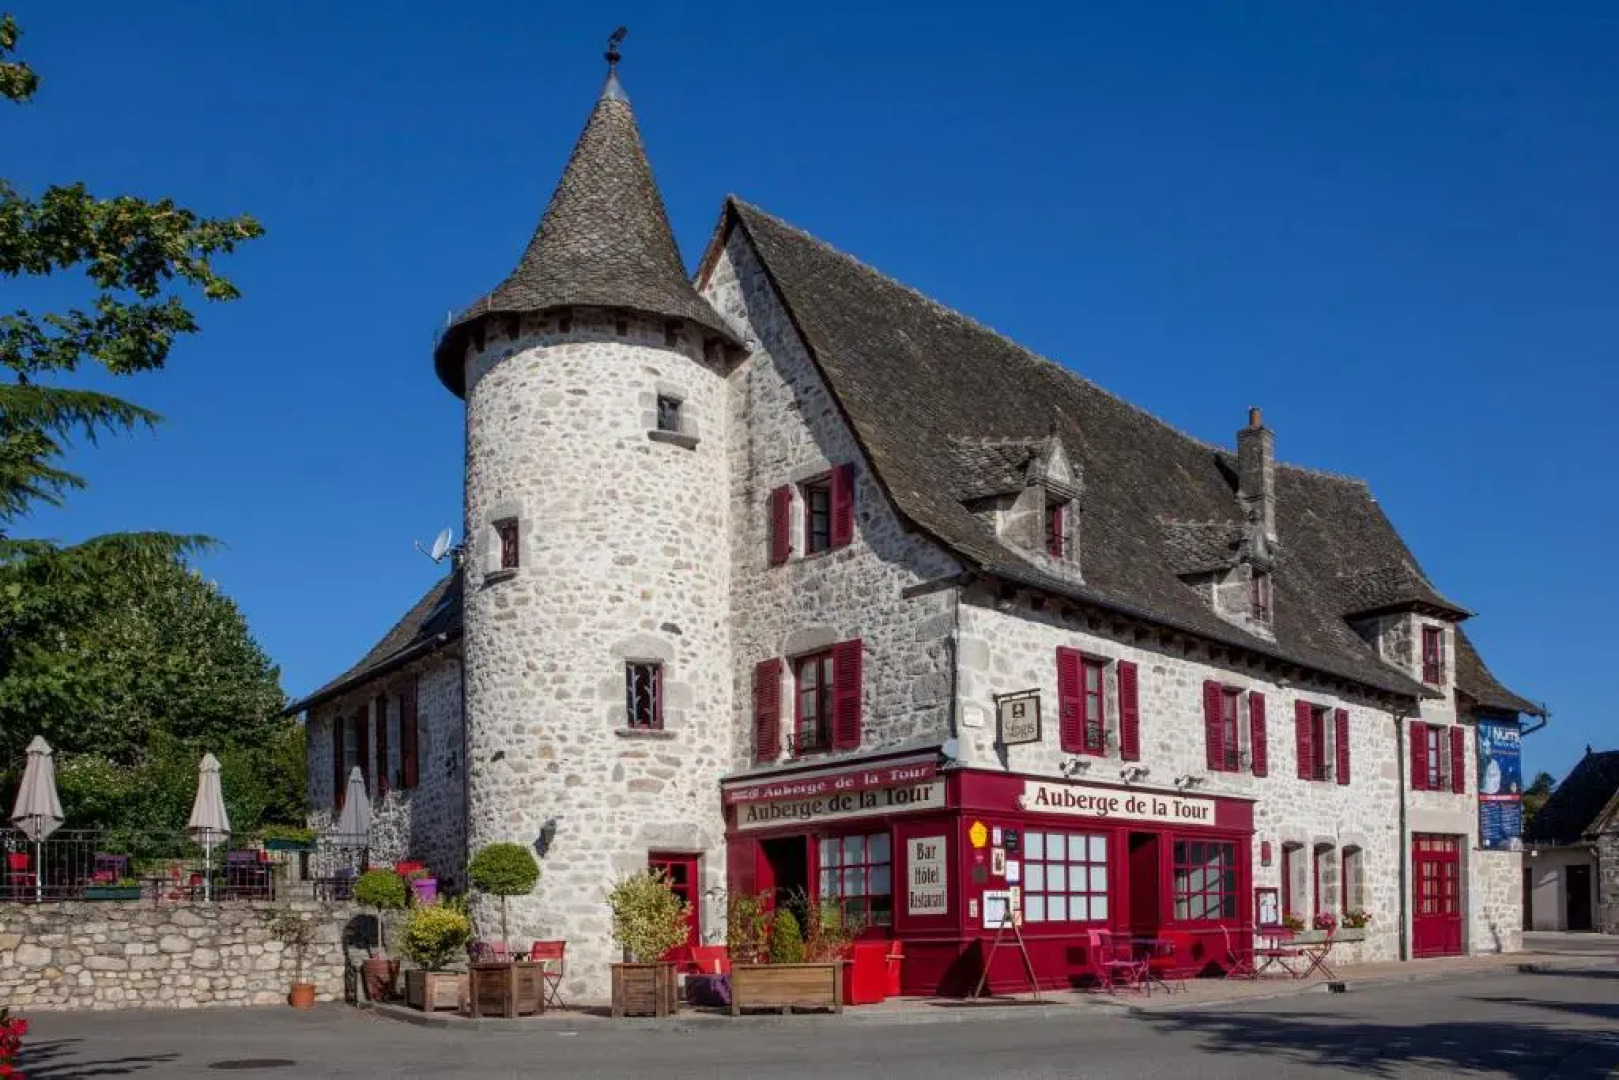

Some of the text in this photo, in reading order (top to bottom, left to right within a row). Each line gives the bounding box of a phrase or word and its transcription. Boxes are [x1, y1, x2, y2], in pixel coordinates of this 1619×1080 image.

[763, 781, 825, 798] Auberge
[835, 777, 855, 789] de
[864, 772, 879, 785] la
[891, 767, 929, 781] Tour
[746, 785, 933, 822] Auberge de la Tour
[1035, 786, 1209, 820] Auberge de la Tour
[916, 842, 937, 861] Bar
[914, 866, 940, 884] Hôtel
[909, 890, 945, 909] Restaurant
